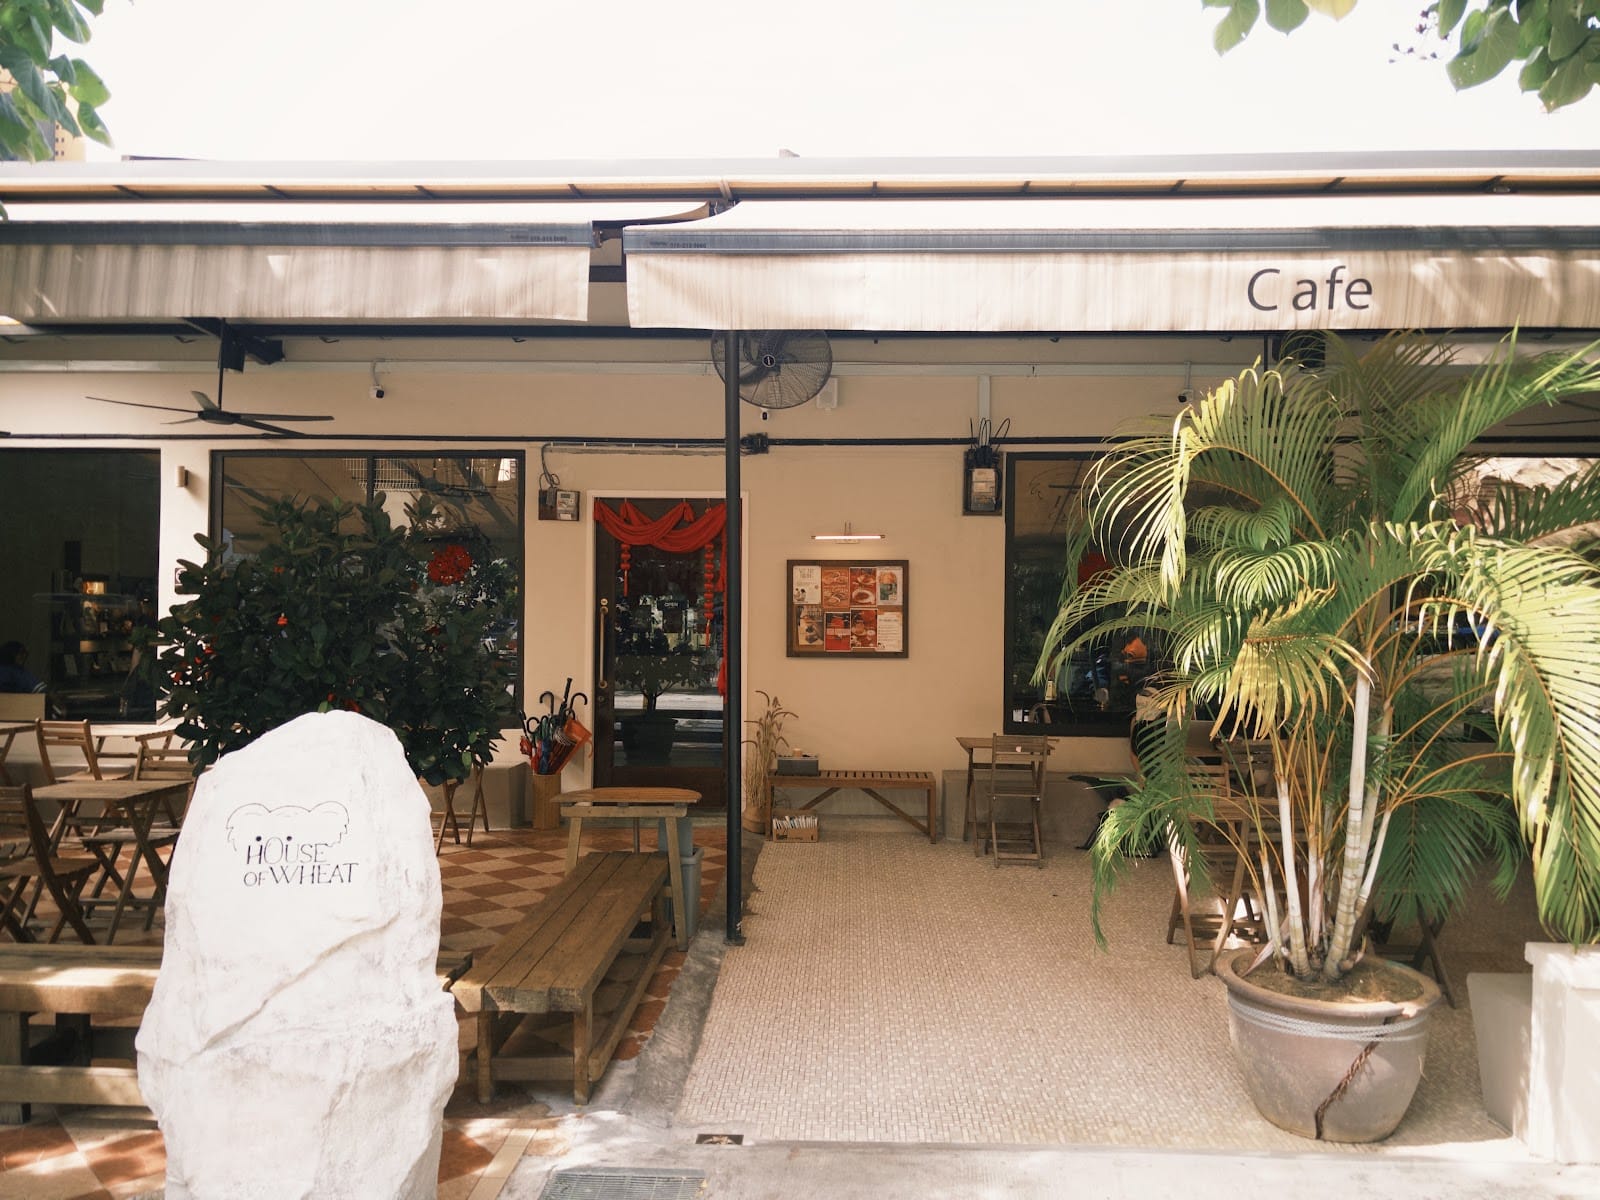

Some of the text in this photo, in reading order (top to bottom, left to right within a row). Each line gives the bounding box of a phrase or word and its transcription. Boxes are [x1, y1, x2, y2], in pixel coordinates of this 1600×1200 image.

[1247, 265, 1373, 311] Cafe
[246, 837, 327, 865] HOUSE
[243, 863, 359, 887] OF WHEAT
